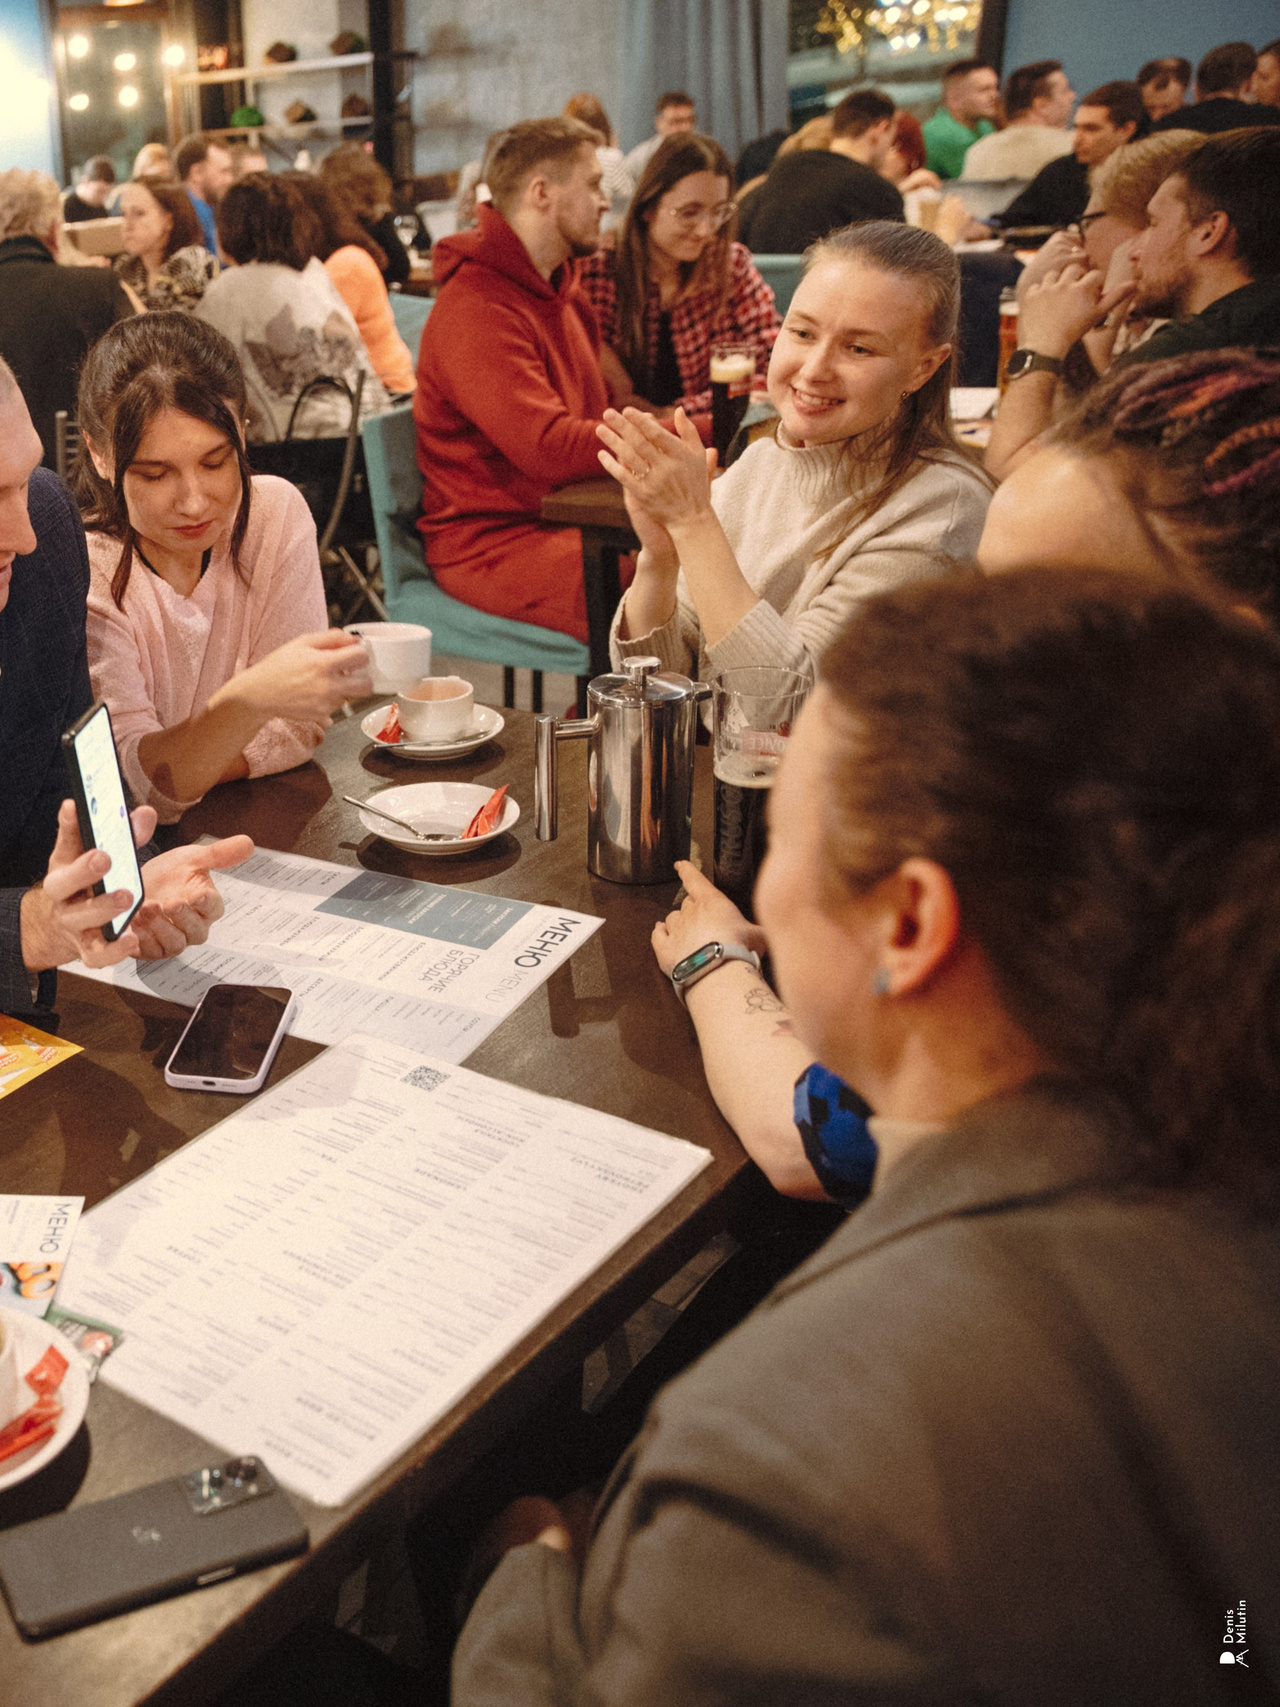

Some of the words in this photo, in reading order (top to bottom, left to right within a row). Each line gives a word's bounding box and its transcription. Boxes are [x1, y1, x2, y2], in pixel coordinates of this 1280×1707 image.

[513, 917, 582, 969] МЕНЮ
[415, 948, 465, 983] БЛЮДА
[425, 952, 481, 993] ГОРЯЧИЕ
[482, 968, 529, 1003] MENU
[37, 1202, 72, 1253] МЕНЮ
